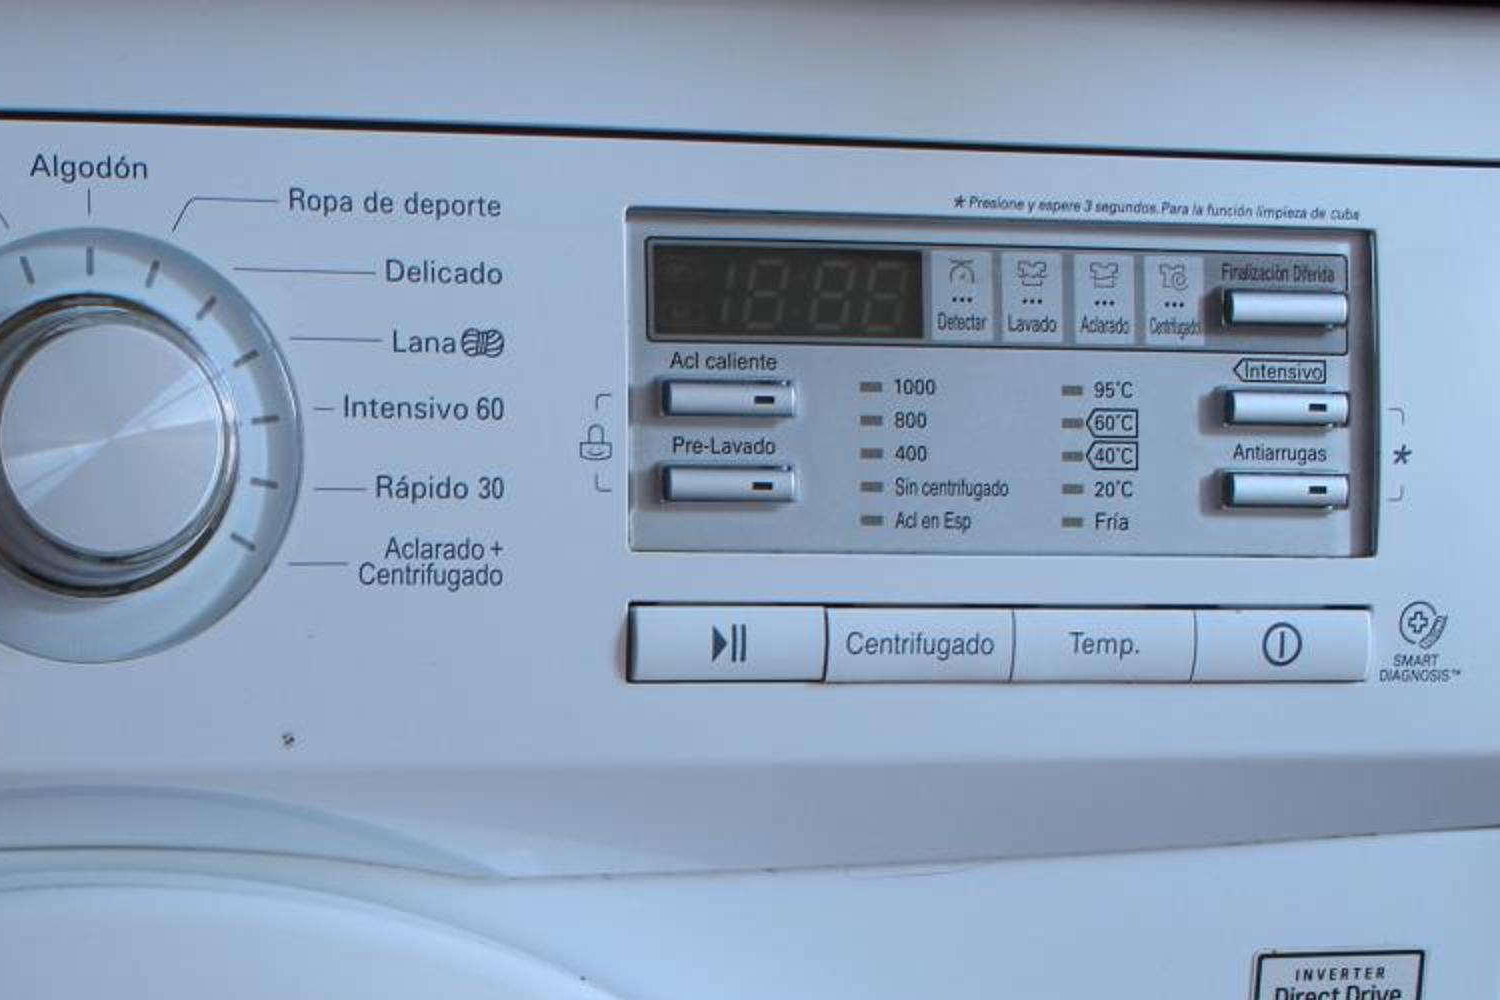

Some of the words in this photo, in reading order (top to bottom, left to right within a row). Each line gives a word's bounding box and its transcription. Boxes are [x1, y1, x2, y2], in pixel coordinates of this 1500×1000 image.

[30, 154, 147, 183] Algodón
[289, 187, 352, 216] Ropa
[364, 192, 393, 214] de
[404, 192, 500, 220] deporte
[969, 196, 1024, 210] Presione
[1028, 201, 1036, 213] y
[1038, 201, 1080, 214] espere
[1083, 200, 1092, 212] 3
[1162, 202, 1189, 216] Para
[1192, 204, 1204, 216] la
[1207, 203, 1252, 217] función
[1256, 205, 1307, 220] limpieza
[1310, 208, 1326, 219] de
[386, 259, 502, 284] Delicado
[1222, 262, 1288, 281] Finalización
[1293, 264, 1334, 283] Diferida
[938, 312, 987, 331] Detectar
[1008, 315, 1056, 333] Lavado
[1080, 315, 1129, 334] Aclarado
[1150, 316, 1202, 340] Centrifugado
[393, 330, 456, 354] Lana
[706, 352, 777, 370] caliente
[1245, 362, 1323, 381] Intensivo
[895, 379, 936, 395] 1000
[344, 394, 468, 420] Intensivo
[476, 397, 504, 420] 60
[894, 411, 927, 428] 800
[673, 436, 775, 455] Pre-Lavado
[895, 445, 927, 462] 400
[1233, 443, 1327, 466] Antiarrugas
[376, 475, 468, 504] Rápido
[479, 477, 504, 499] 30
[895, 477, 918, 496] Sin
[922, 479, 1009, 501] centrifugado
[922, 516, 939, 529] en
[944, 512, 972, 534] Esp
[1096, 512, 1128, 530] Fría
[385, 537, 484, 560] Aclarado
[359, 562, 503, 592] Centrifugado
[846, 632, 994, 661] Centrifugado
[1069, 632, 1140, 660] Temp.
[1393, 654, 1439, 667] SMART
[1296, 967, 1384, 981] INVERTER
